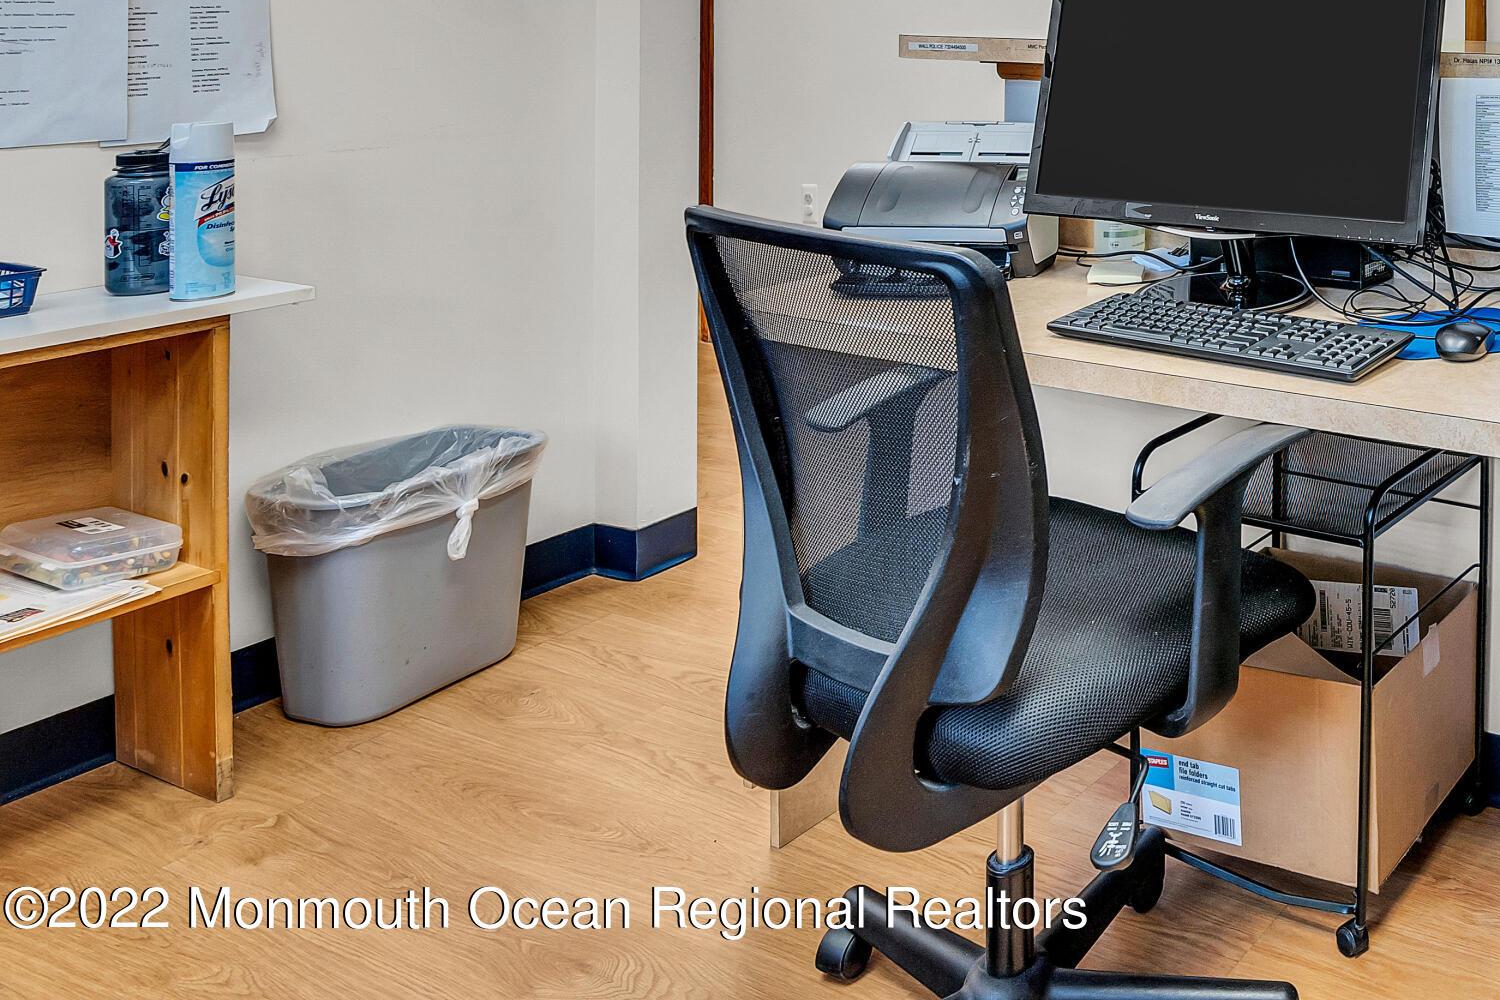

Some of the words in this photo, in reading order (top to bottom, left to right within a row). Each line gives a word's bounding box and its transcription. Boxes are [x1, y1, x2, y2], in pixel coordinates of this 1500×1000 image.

[1194, 213, 1220, 222] ViewSonic
[1189, 768, 1208, 779] folders
[1201, 779, 1217, 788] straight
